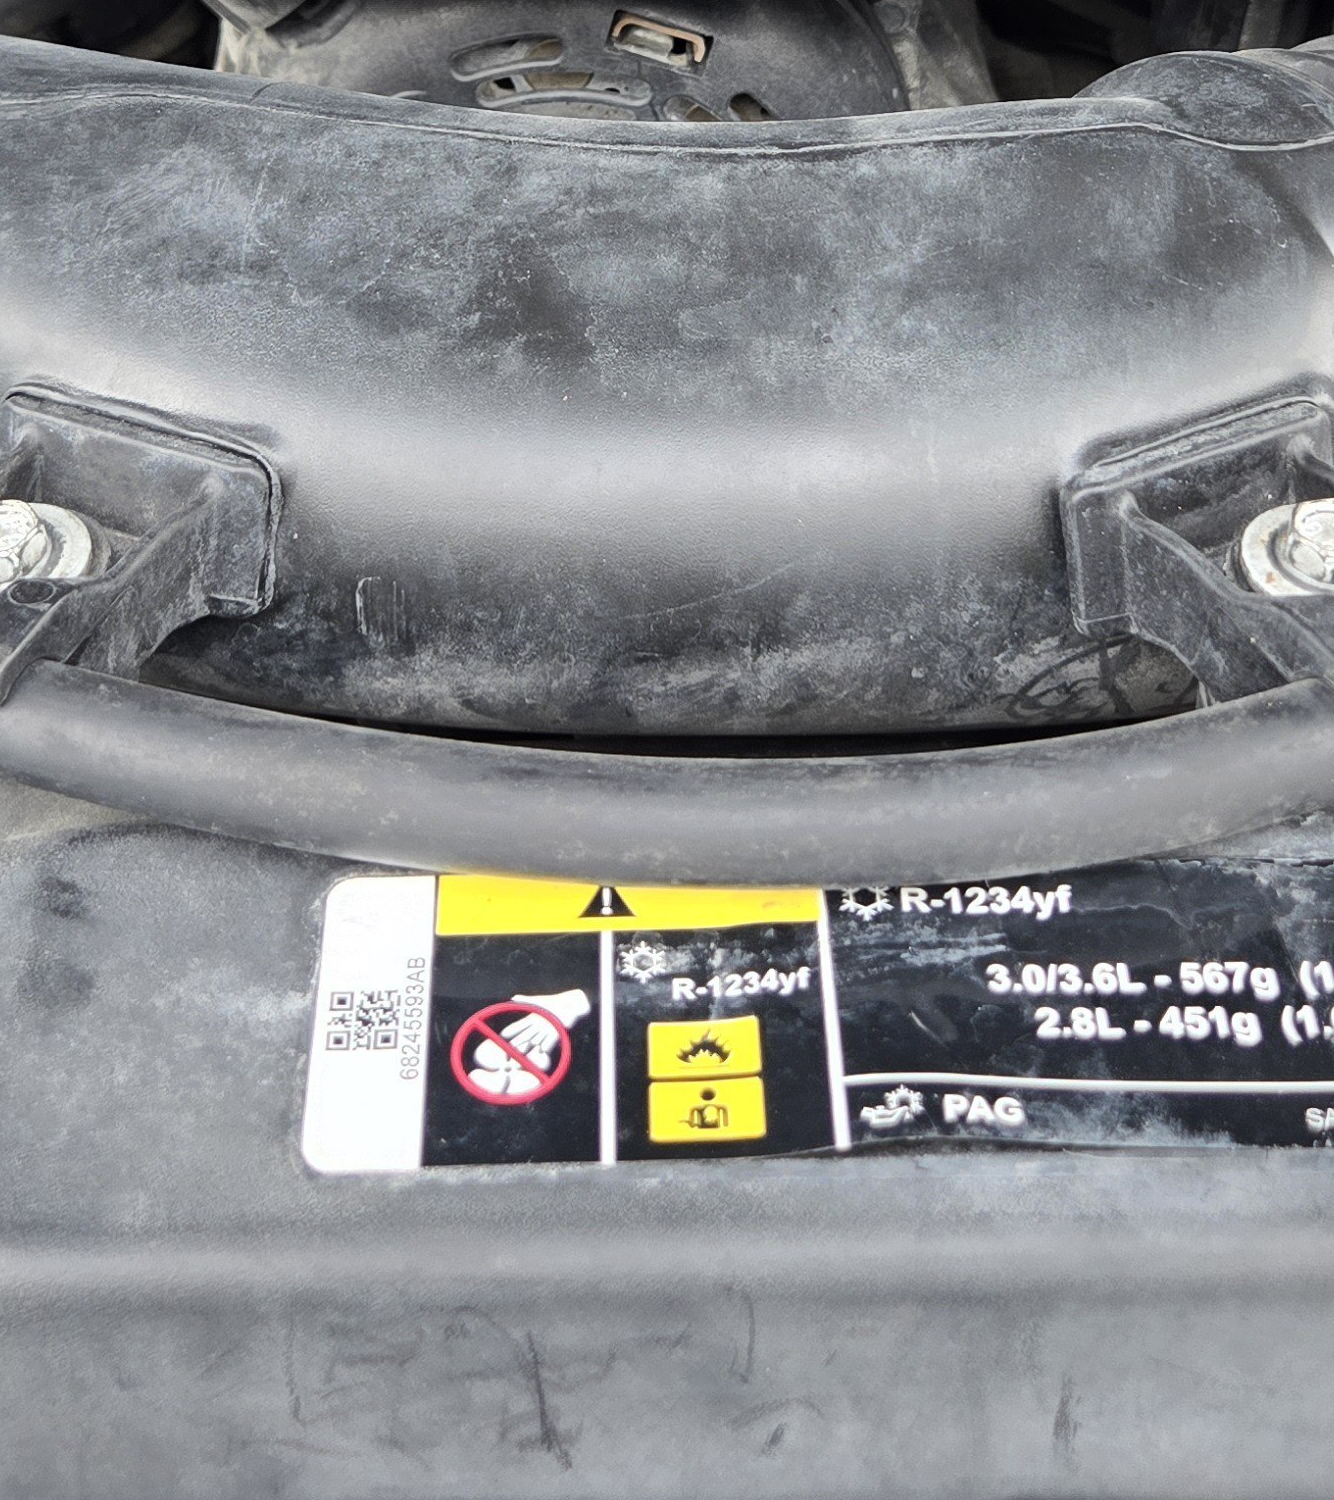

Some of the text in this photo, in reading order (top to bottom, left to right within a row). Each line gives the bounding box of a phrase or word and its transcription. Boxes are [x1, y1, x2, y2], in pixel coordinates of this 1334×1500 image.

[901, 885, 1072, 920] R-1234yf
[672, 966, 811, 1000] R-1234yf
[985, 963, 1147, 994] 3.0/3.6L
[1179, 961, 1281, 1000] 567g
[400, 957, 425, 1080] 68245593AB
[1034, 1006, 1126, 1040] 2.8L
[1158, 1005, 1262, 1047] 451g
[943, 1095, 1024, 1126] PAG
